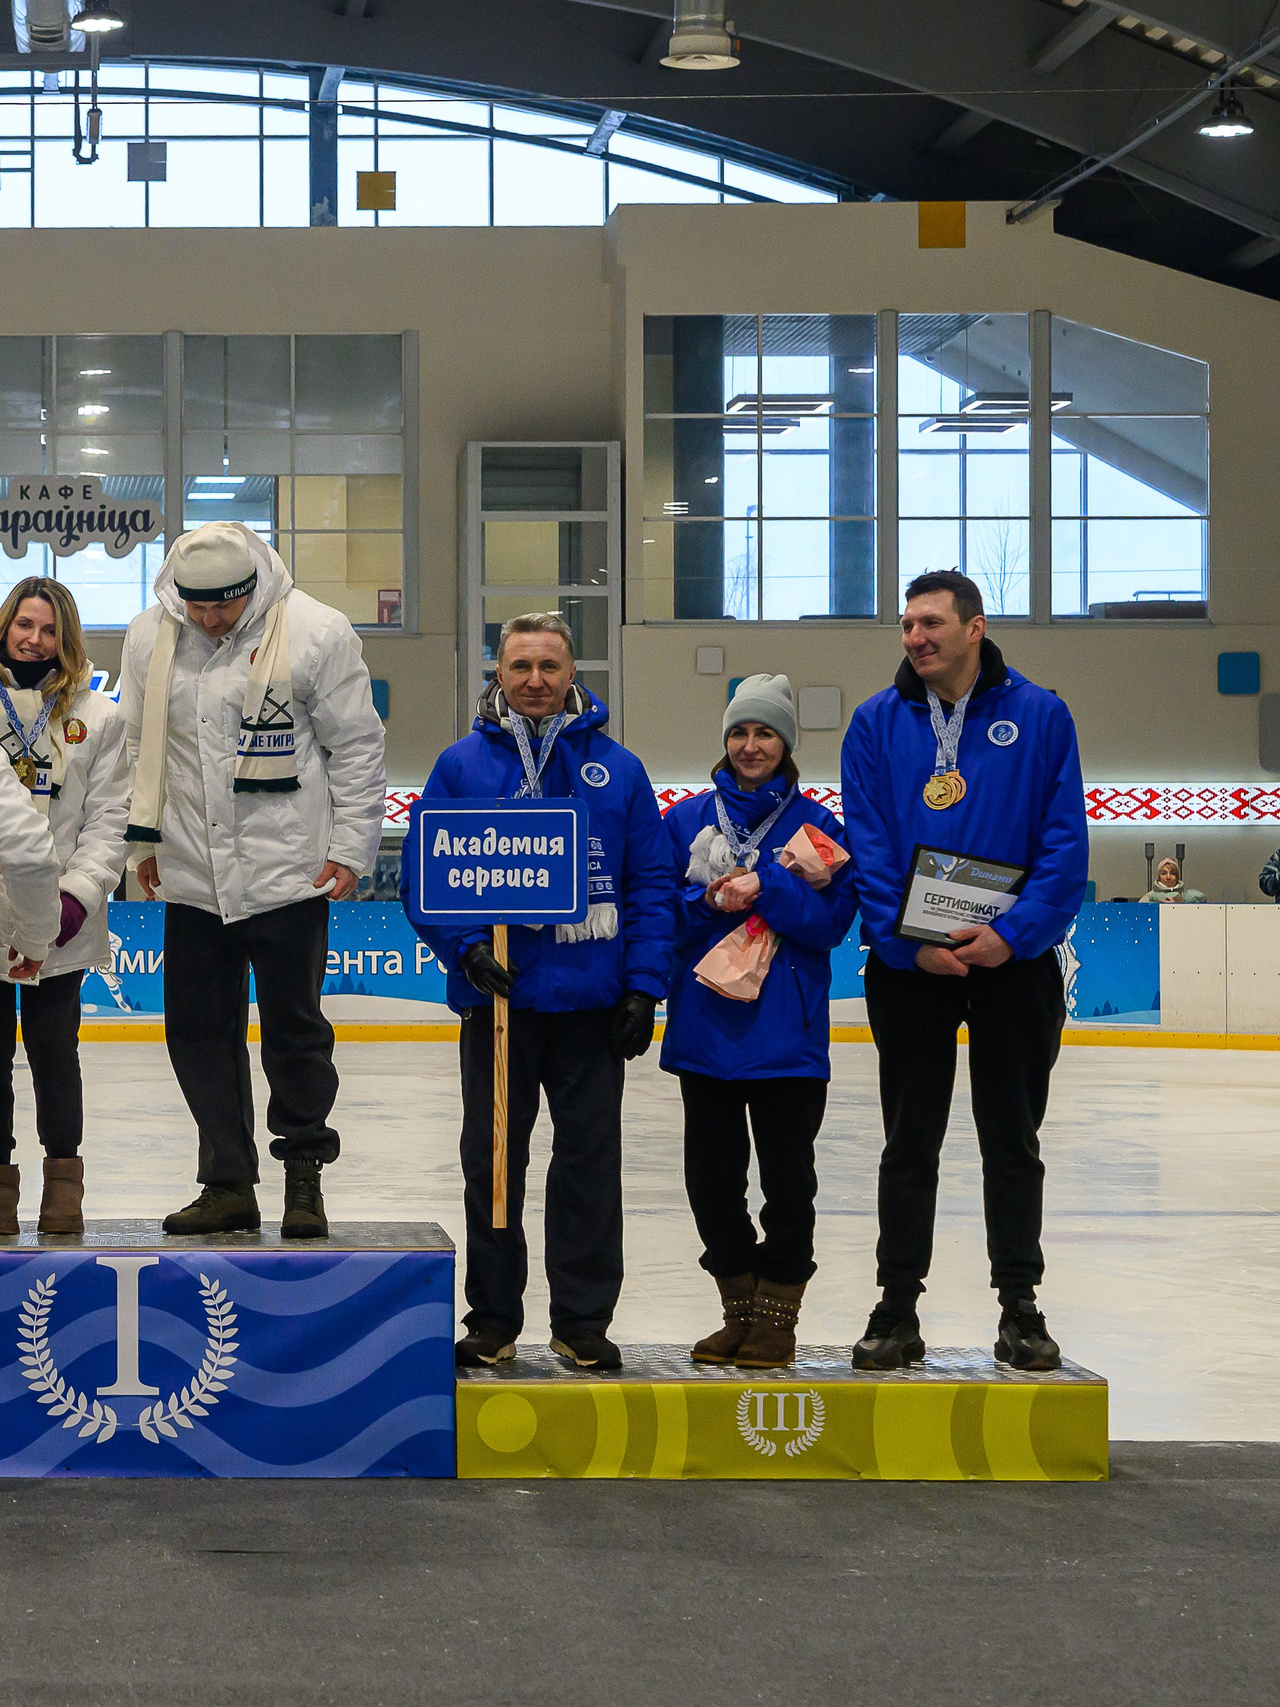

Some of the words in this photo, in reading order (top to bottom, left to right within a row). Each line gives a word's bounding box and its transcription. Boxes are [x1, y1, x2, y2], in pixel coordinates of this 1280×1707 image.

[19, 484, 93, 501] КАФЕ
[432, 826, 565, 858] Академия
[448, 865, 550, 897] сервиса
[923, 892, 1001, 918] СЕРТИФИКАТ
[89, 948, 165, 975] ами
[753, 1391, 811, 1432] III
